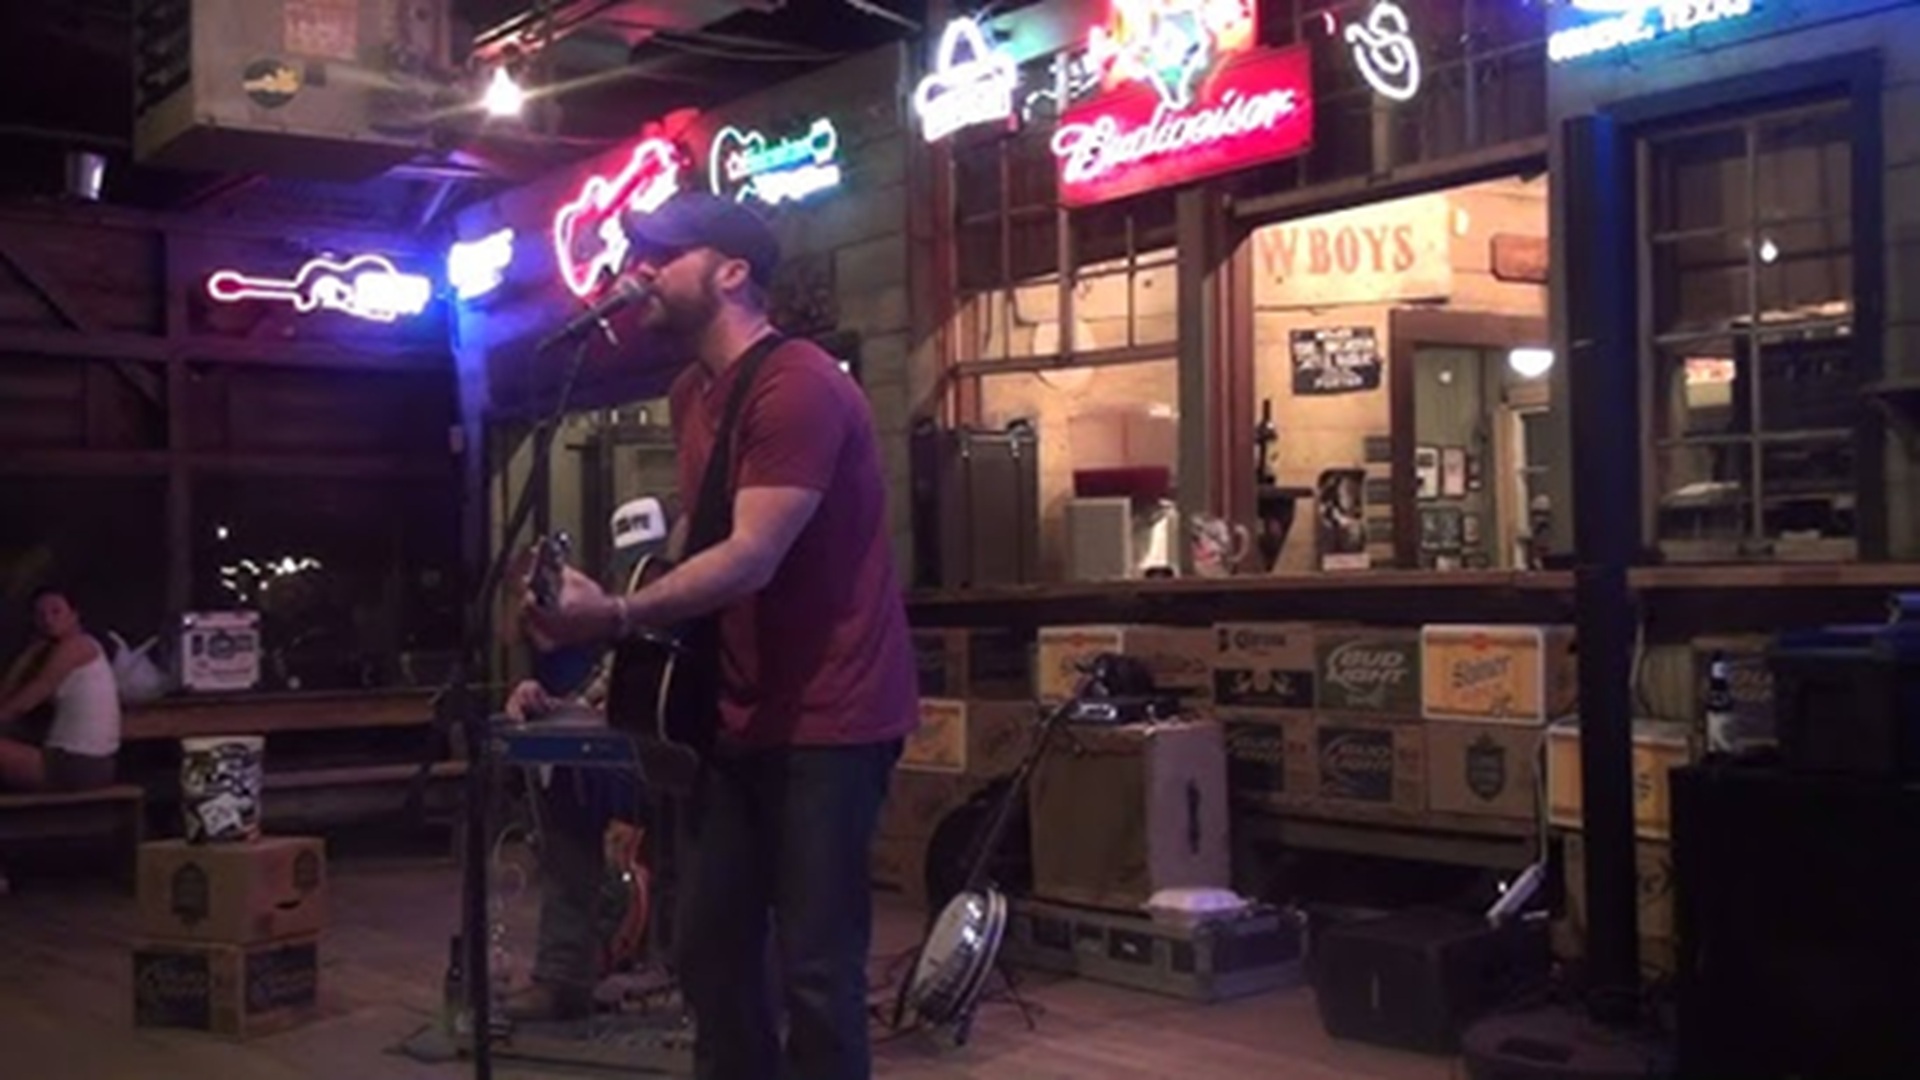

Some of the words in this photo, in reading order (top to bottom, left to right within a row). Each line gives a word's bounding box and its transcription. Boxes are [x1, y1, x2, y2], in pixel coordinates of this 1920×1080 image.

[1052, 86, 1297, 184] Budweiser
[1341, 650, 1406, 668] BUD
[1325, 665, 1410, 684] LIGHT
